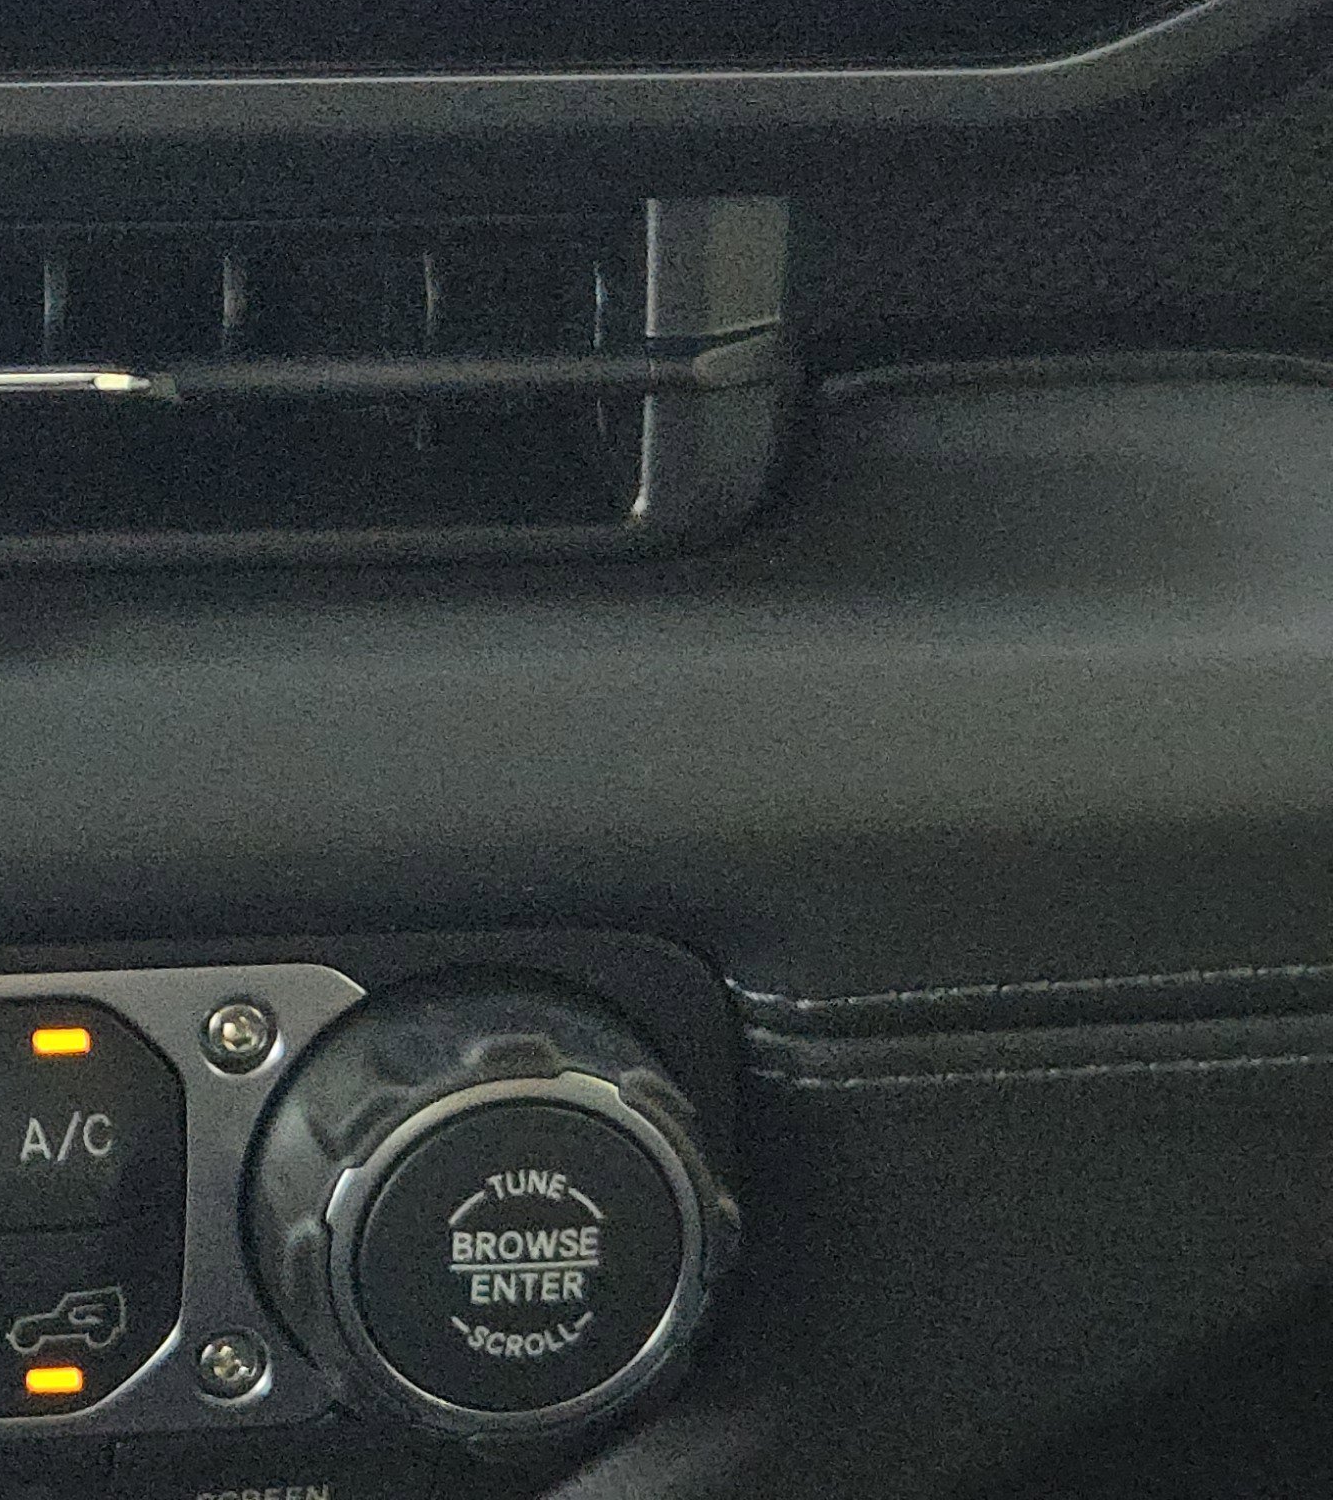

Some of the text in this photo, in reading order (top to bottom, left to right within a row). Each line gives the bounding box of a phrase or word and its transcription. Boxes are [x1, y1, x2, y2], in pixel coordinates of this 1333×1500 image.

[20, 1110, 113, 1162] A/C
[486, 1169, 567, 1200] TUNE
[452, 1226, 600, 1261] BROWSE
[470, 1271, 584, 1304] ENTER
[467, 1323, 581, 1358] SCROLL
